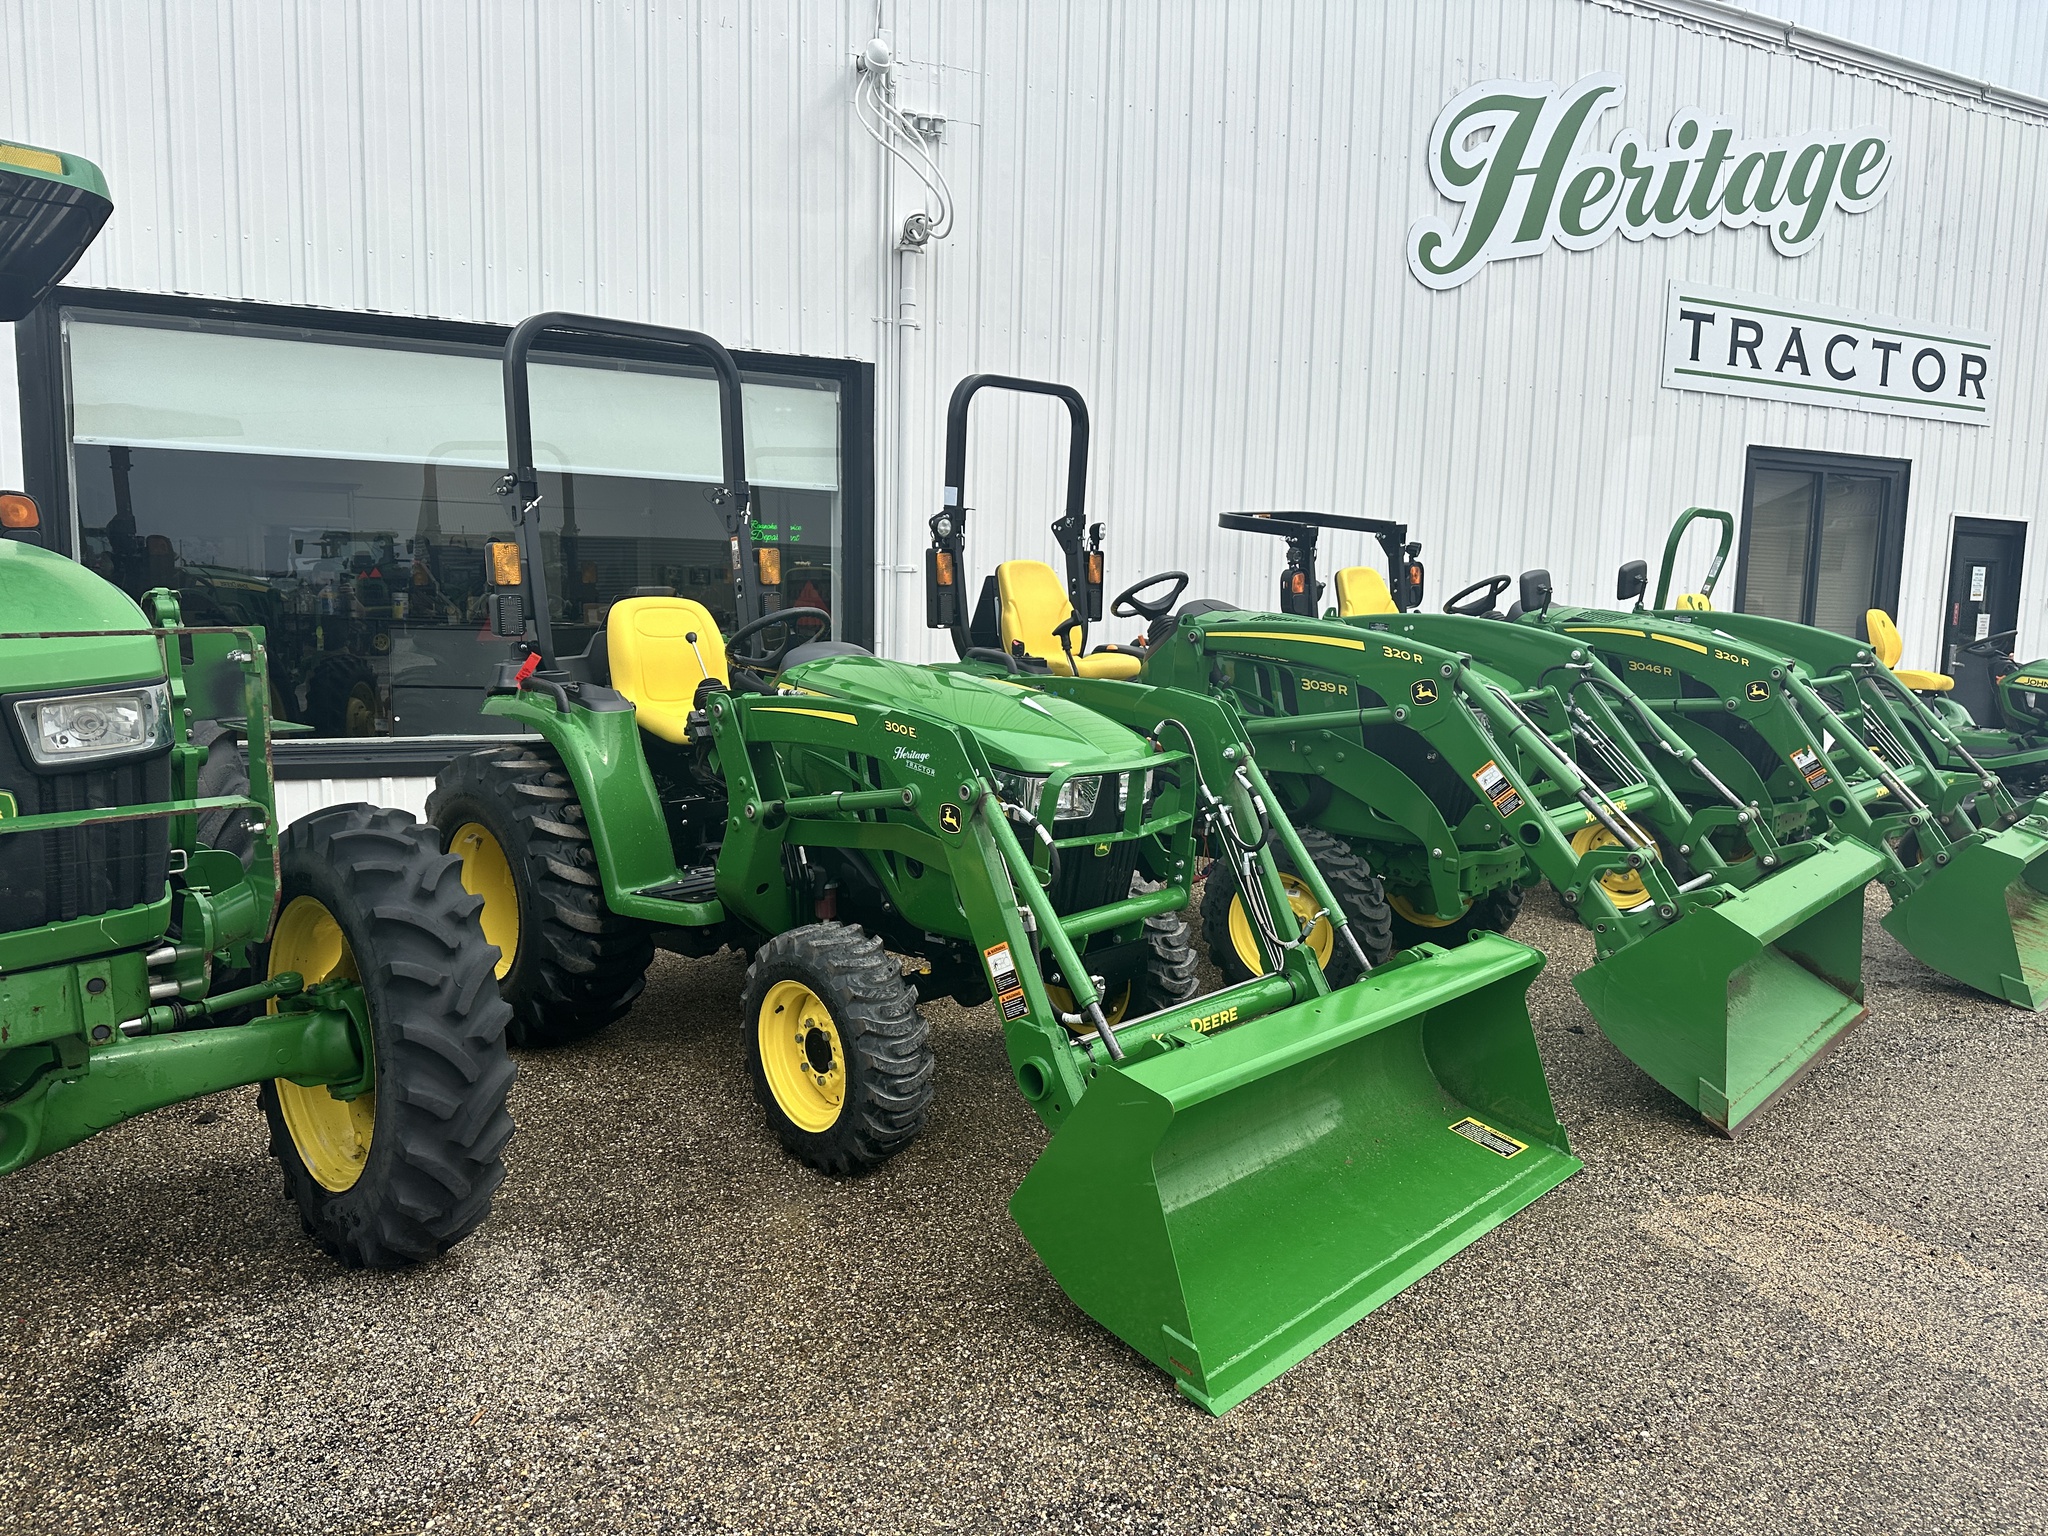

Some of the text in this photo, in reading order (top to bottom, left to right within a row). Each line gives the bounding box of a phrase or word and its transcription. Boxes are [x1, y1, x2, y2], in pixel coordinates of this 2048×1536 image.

[1418, 86, 1892, 275] Heritage
[1679, 308, 1987, 400] TRACTOR
[1382, 646, 1423, 665] 320 R
[1714, 649, 1750, 667] 320 R
[1628, 660, 1673, 677] 3046 R
[1301, 678, 1348, 696] 3039 R
[892, 746, 930, 762] Heritage
[906, 760, 935, 776] TRACTOR
[1190, 1006, 1239, 1033] DEERE
